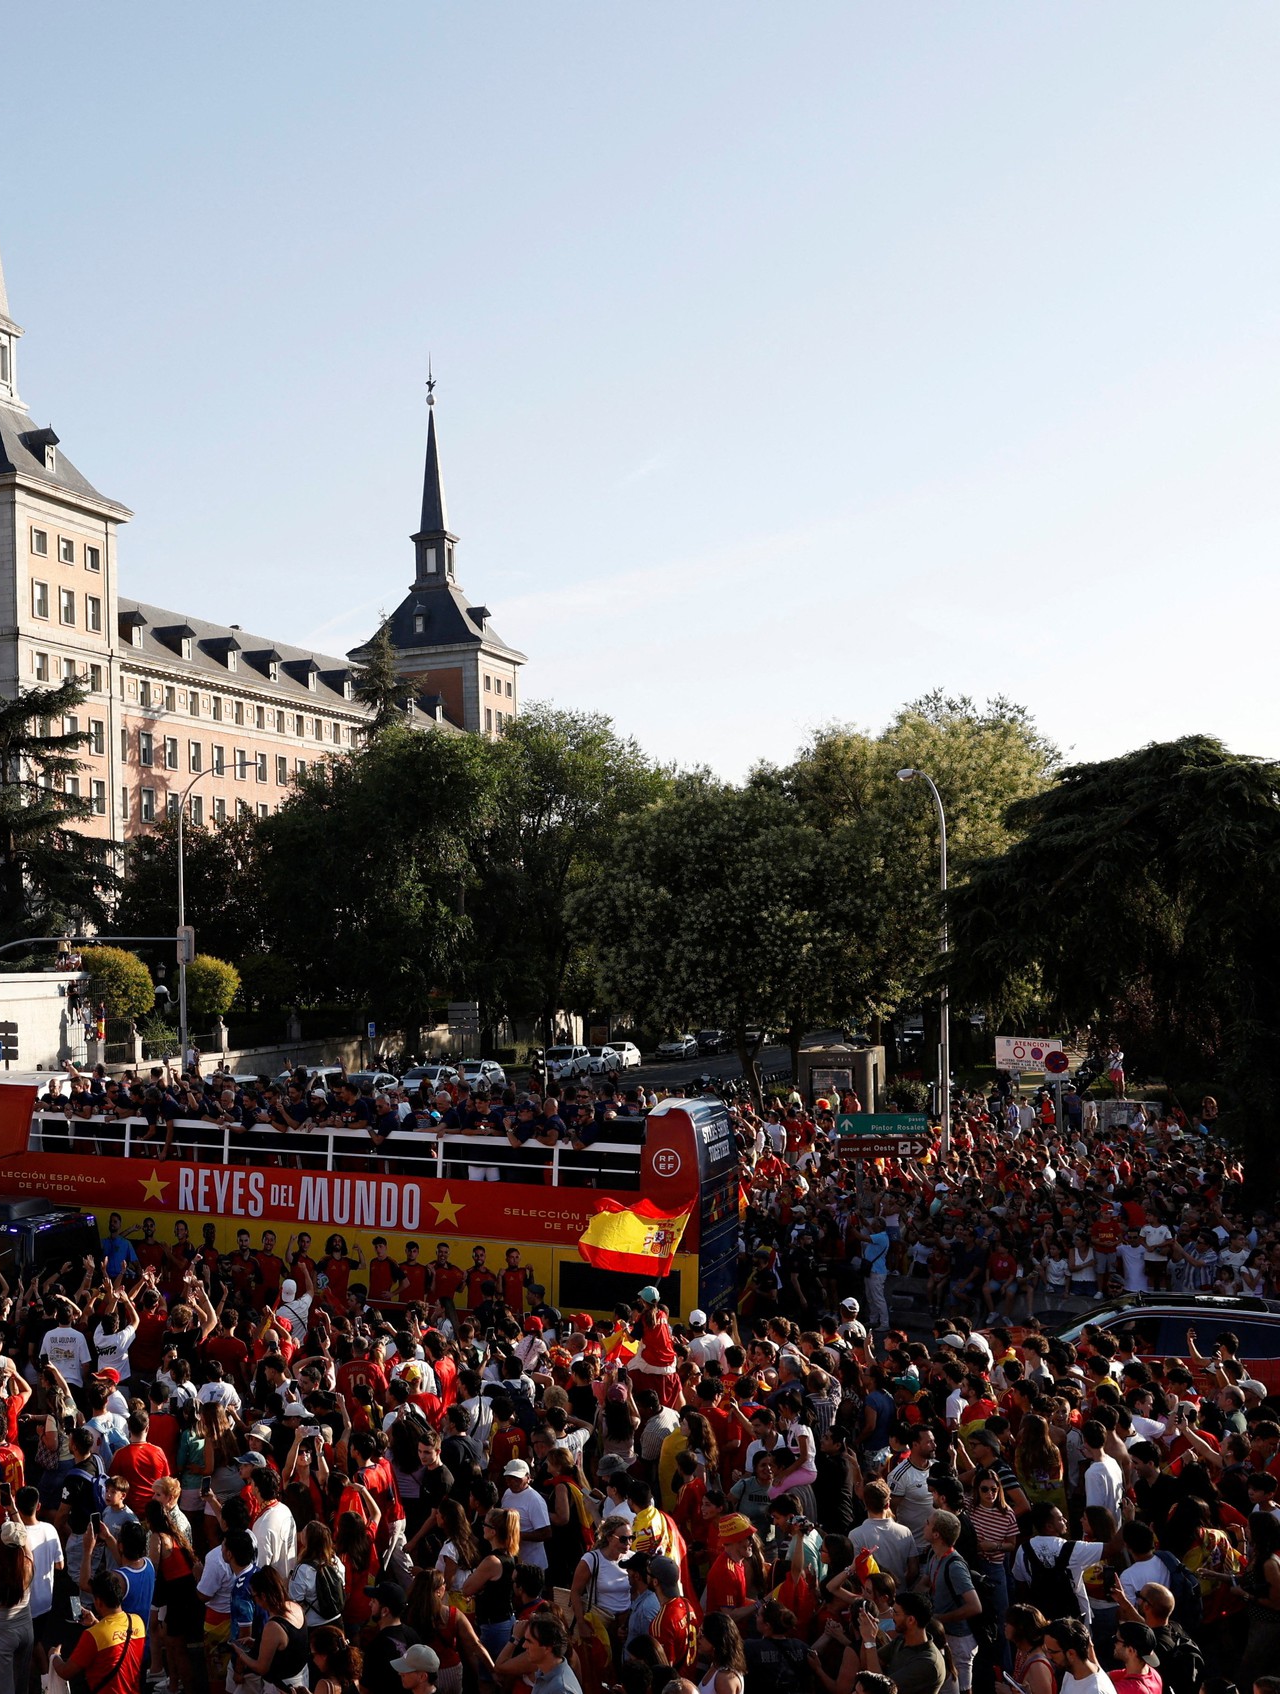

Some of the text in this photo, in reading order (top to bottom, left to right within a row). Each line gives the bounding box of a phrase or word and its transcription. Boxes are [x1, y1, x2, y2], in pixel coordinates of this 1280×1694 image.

[49, 1173, 106, 1185] ESPAÑOLA
[18, 1180, 77, 1192] DE FÚTBOL
[178, 1167, 420, 1230] REYES DEL MUNDO
[503, 1207, 580, 1221] SELECCIÓN
[544, 1221, 562, 1230] DE
